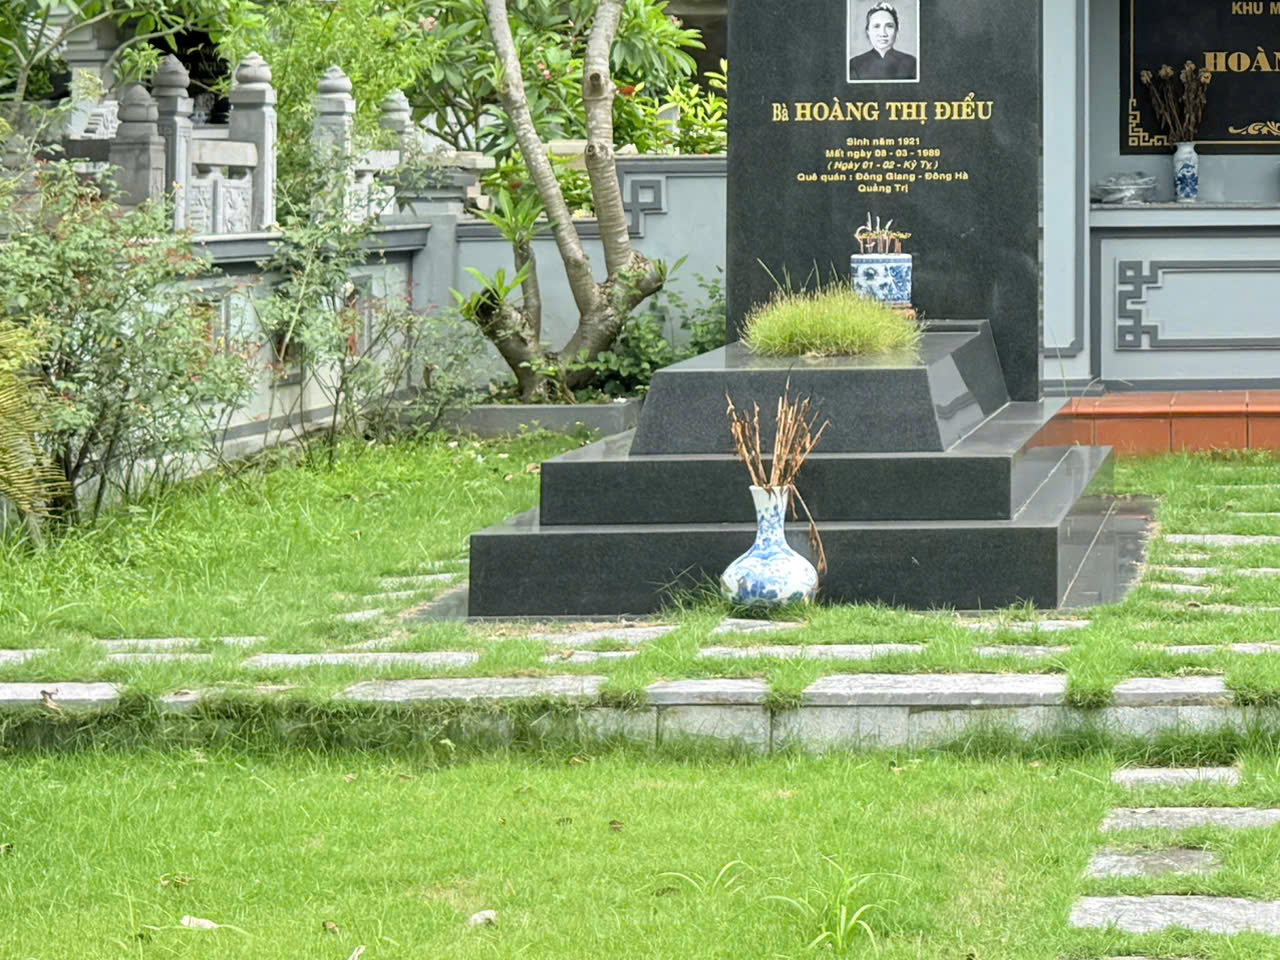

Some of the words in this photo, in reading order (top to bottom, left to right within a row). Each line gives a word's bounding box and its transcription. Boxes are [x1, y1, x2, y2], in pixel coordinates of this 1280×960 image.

[1231, 1, 1264, 15] KHU
[772, 102, 789, 122] Bà
[794, 96, 880, 122] HOÀNG
[885, 101, 928, 126] THỊ
[933, 91, 994, 121] ĐIỂU
[846, 137, 870, 147] Sinh
[872, 137, 895, 147] năm
[897, 137, 920, 146] 1921
[847, 149, 872, 160] ngày
[895, 149, 908, 158] 03
[917, 149, 941, 158] 1989
[862, 160, 874, 170] 01
[882, 160, 896, 170] 02
[797, 172, 818, 183] Quê
[885, 172, 916, 183] Giang
